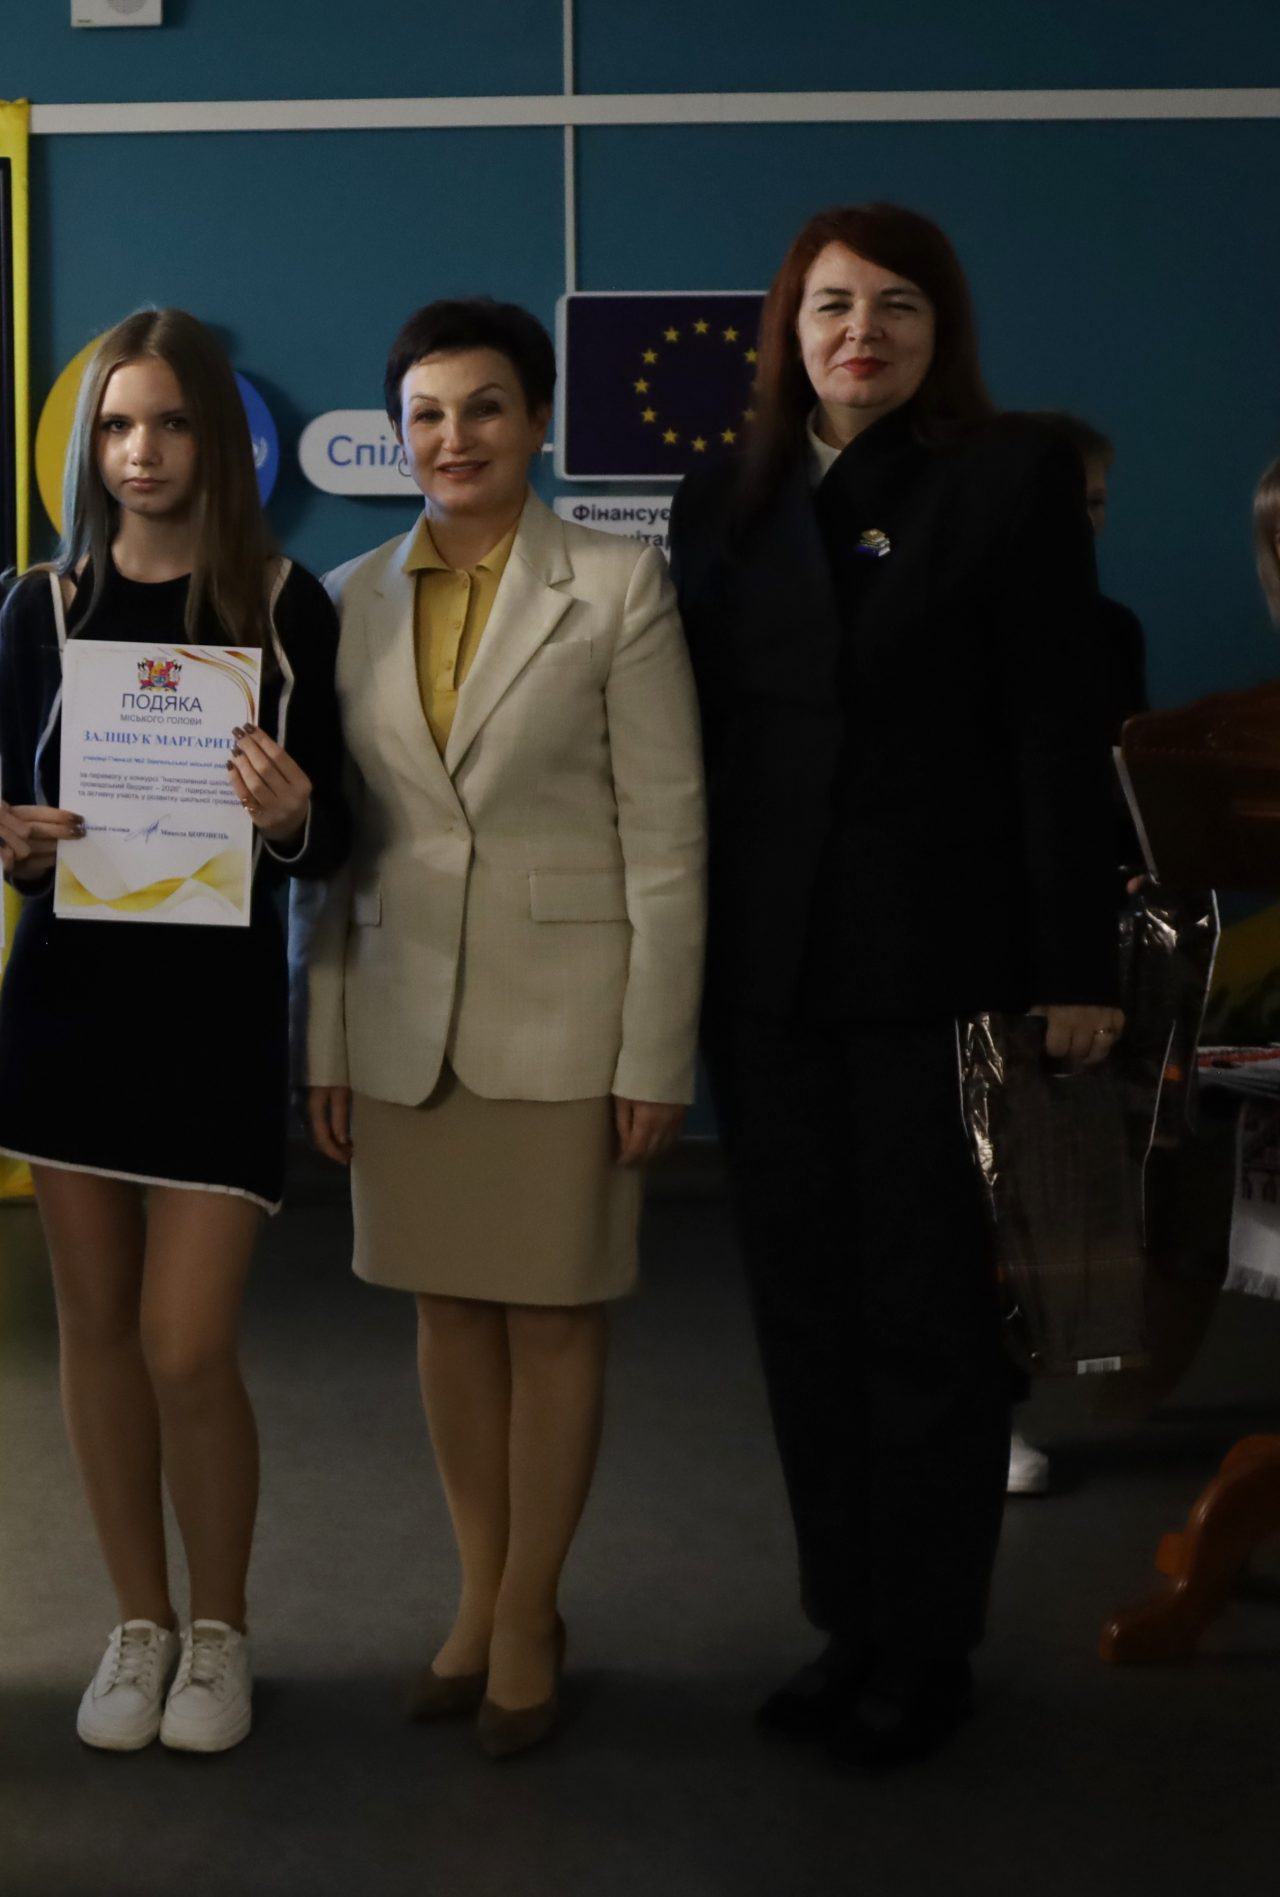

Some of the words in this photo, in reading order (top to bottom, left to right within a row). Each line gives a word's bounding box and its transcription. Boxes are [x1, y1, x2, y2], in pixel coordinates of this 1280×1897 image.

[327, 434, 401, 467] Спіл
[572, 504, 671, 525] Фінансує
[121, 693, 203, 713] ПОДЯКА
[120, 713, 164, 724] МІСЬКОГО
[166, 716, 202, 726] ГОЛОВИ
[82, 730, 151, 745] ЗАЛІЩУК
